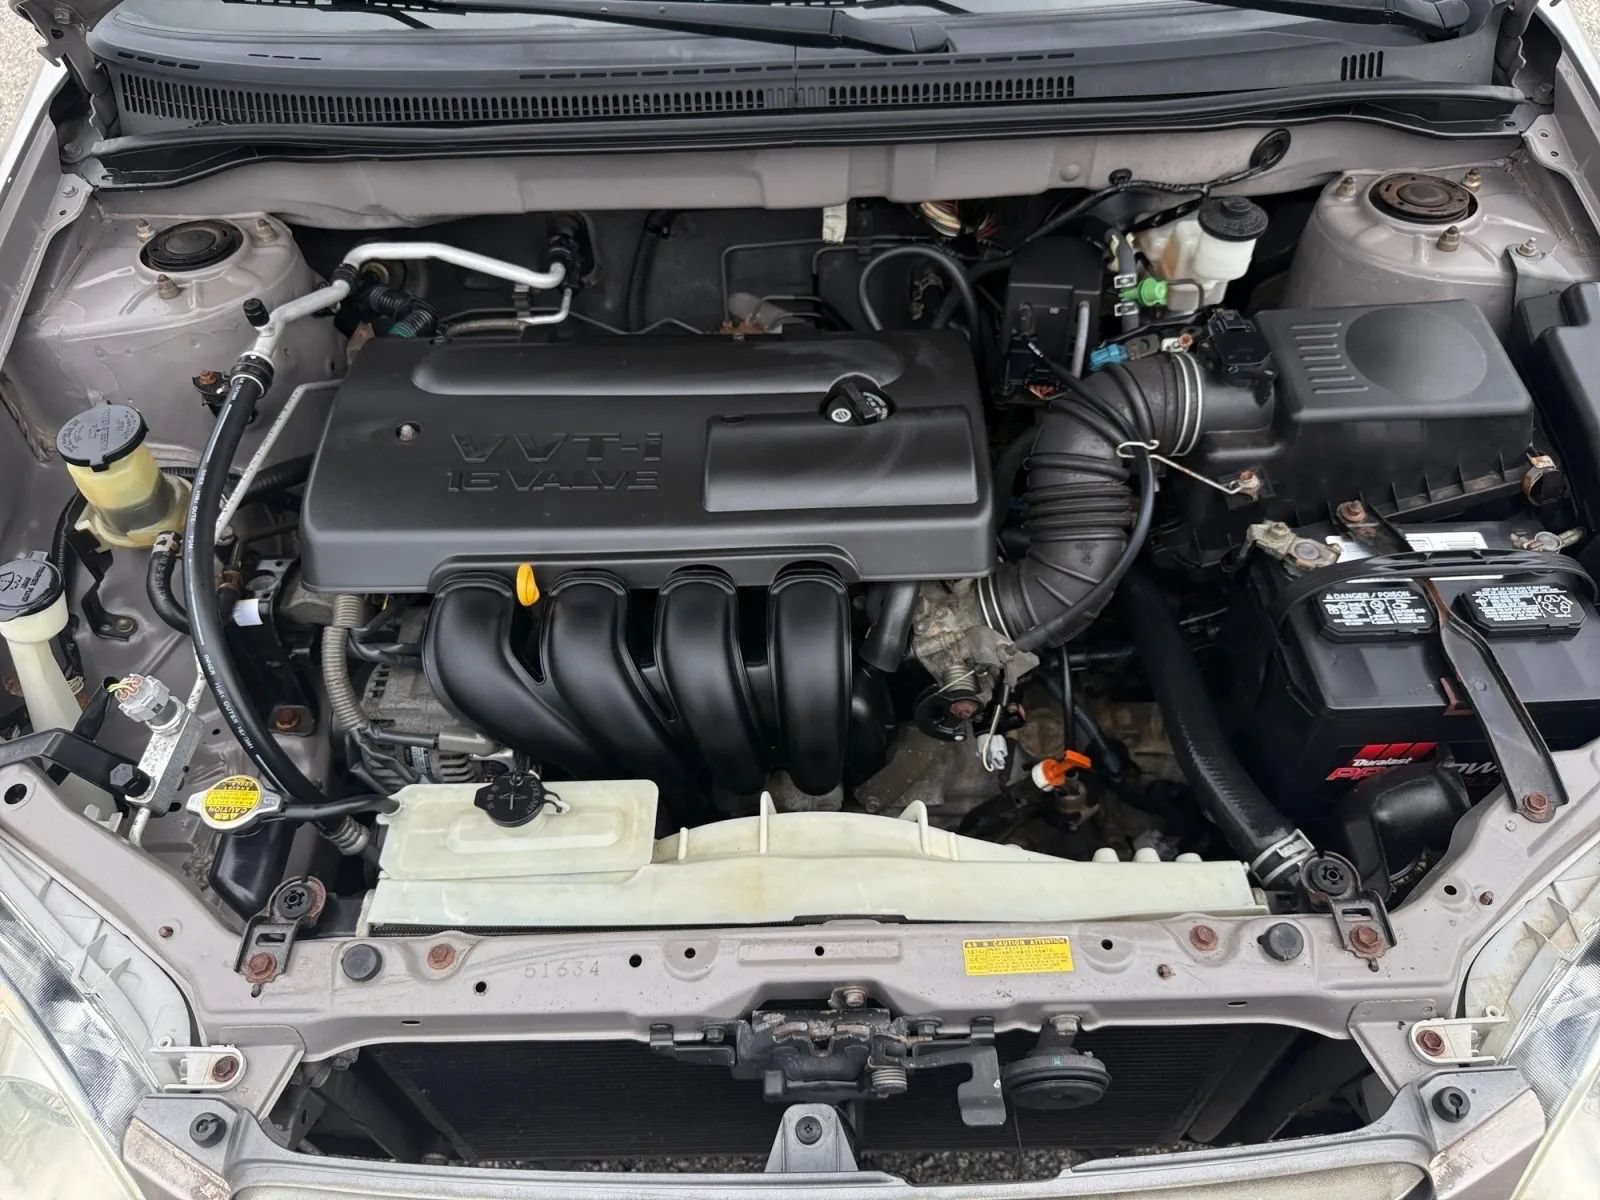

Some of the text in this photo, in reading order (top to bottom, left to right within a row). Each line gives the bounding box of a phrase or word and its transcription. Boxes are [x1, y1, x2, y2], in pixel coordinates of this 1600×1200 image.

[1333, 592, 1370, 600] DANGER
[1378, 590, 1411, 598] POISON
[1352, 757, 1413, 767] Duralast
[993, 939, 1025, 947] CAUTION
[1029, 937, 1065, 945] ATTENTION
[524, 960, 601, 979] 51634
